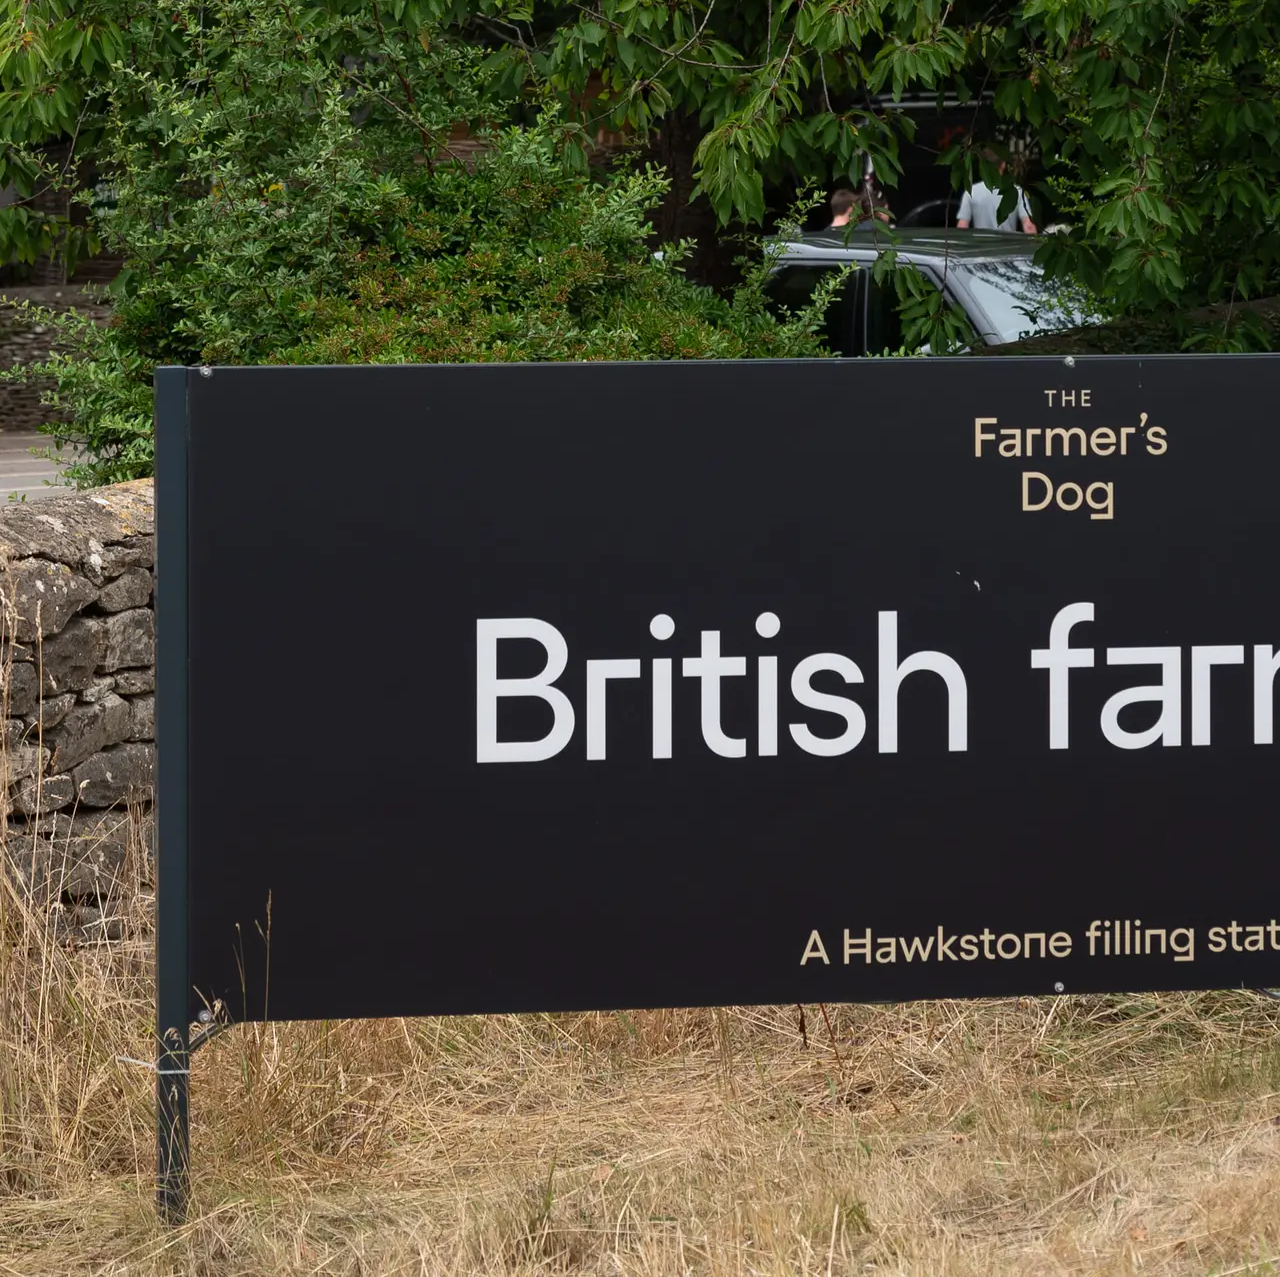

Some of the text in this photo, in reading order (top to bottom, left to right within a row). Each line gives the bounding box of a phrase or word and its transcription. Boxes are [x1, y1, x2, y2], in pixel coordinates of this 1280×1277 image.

[1042, 388, 1093, 409] THE
[973, 412, 1169, 459] Farmer's
[1020, 470, 1115, 521] Dog
[475, 610, 969, 764] British
[799, 928, 831, 966] A
[843, 925, 1074, 965] Hawkstone
[1085, 919, 1196, 962] filling
